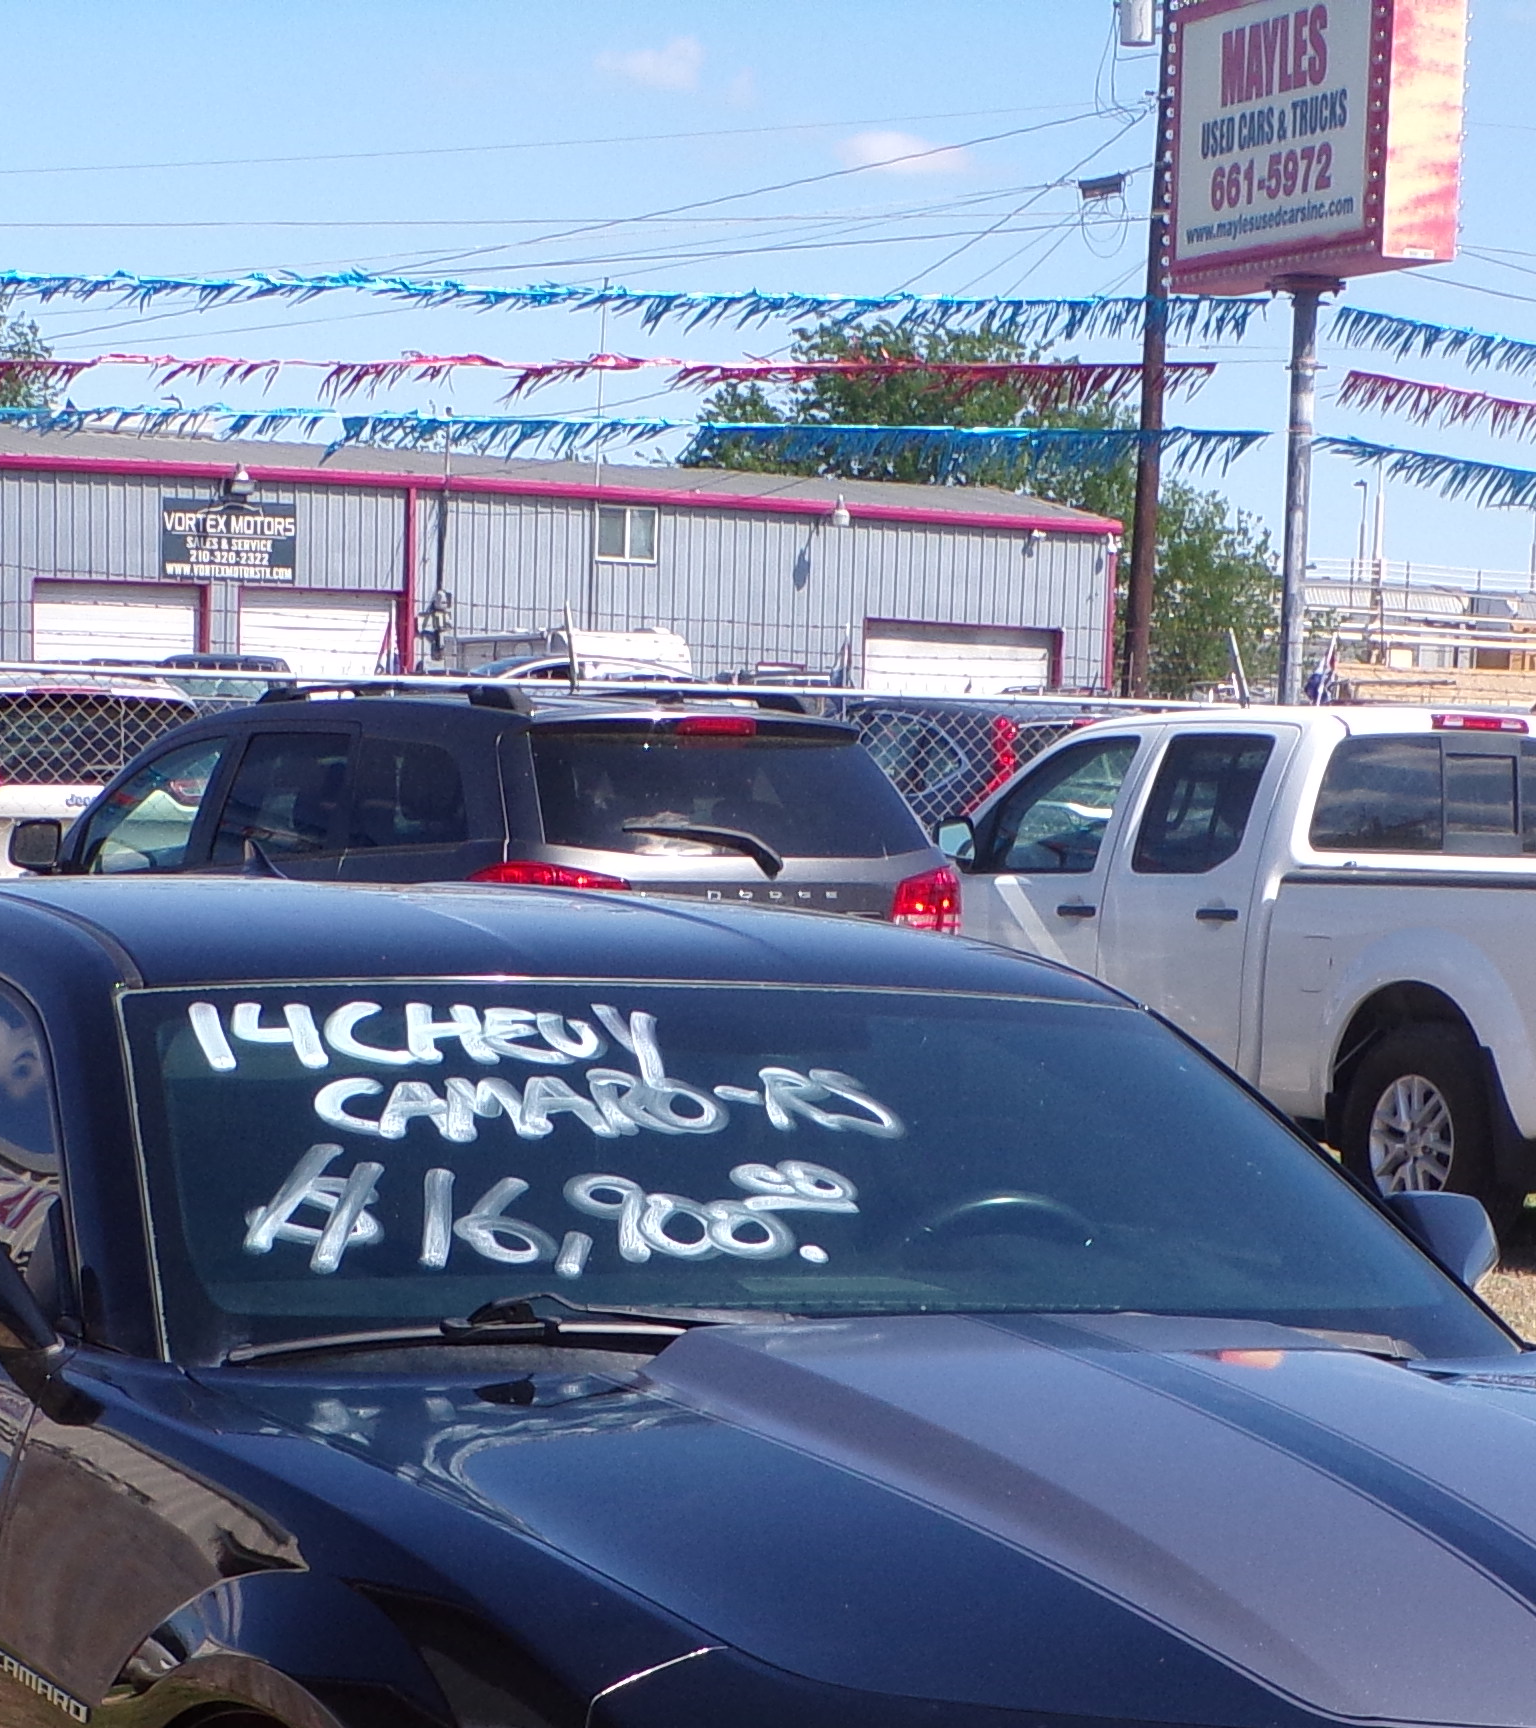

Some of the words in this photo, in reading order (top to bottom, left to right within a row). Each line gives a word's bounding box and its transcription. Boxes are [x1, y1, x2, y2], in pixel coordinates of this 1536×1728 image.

[1221, 4, 1328, 109] MAYLES
[1201, 116, 1236, 160] USED
[1238, 106, 1274, 151] CARS
[1278, 109, 1287, 143] &
[1291, 88, 1348, 140] TRUCKS
[1211, 141, 1332, 211] 661-5972
[163, 511, 227, 533] VORTEX
[230, 514, 295, 536] MOTORS
[185, 536, 219, 549] SALES
[221, 538, 229, 550] &
[231, 538, 273, 552] SERVICE
[189, 550, 269, 565] 210-320-2322
